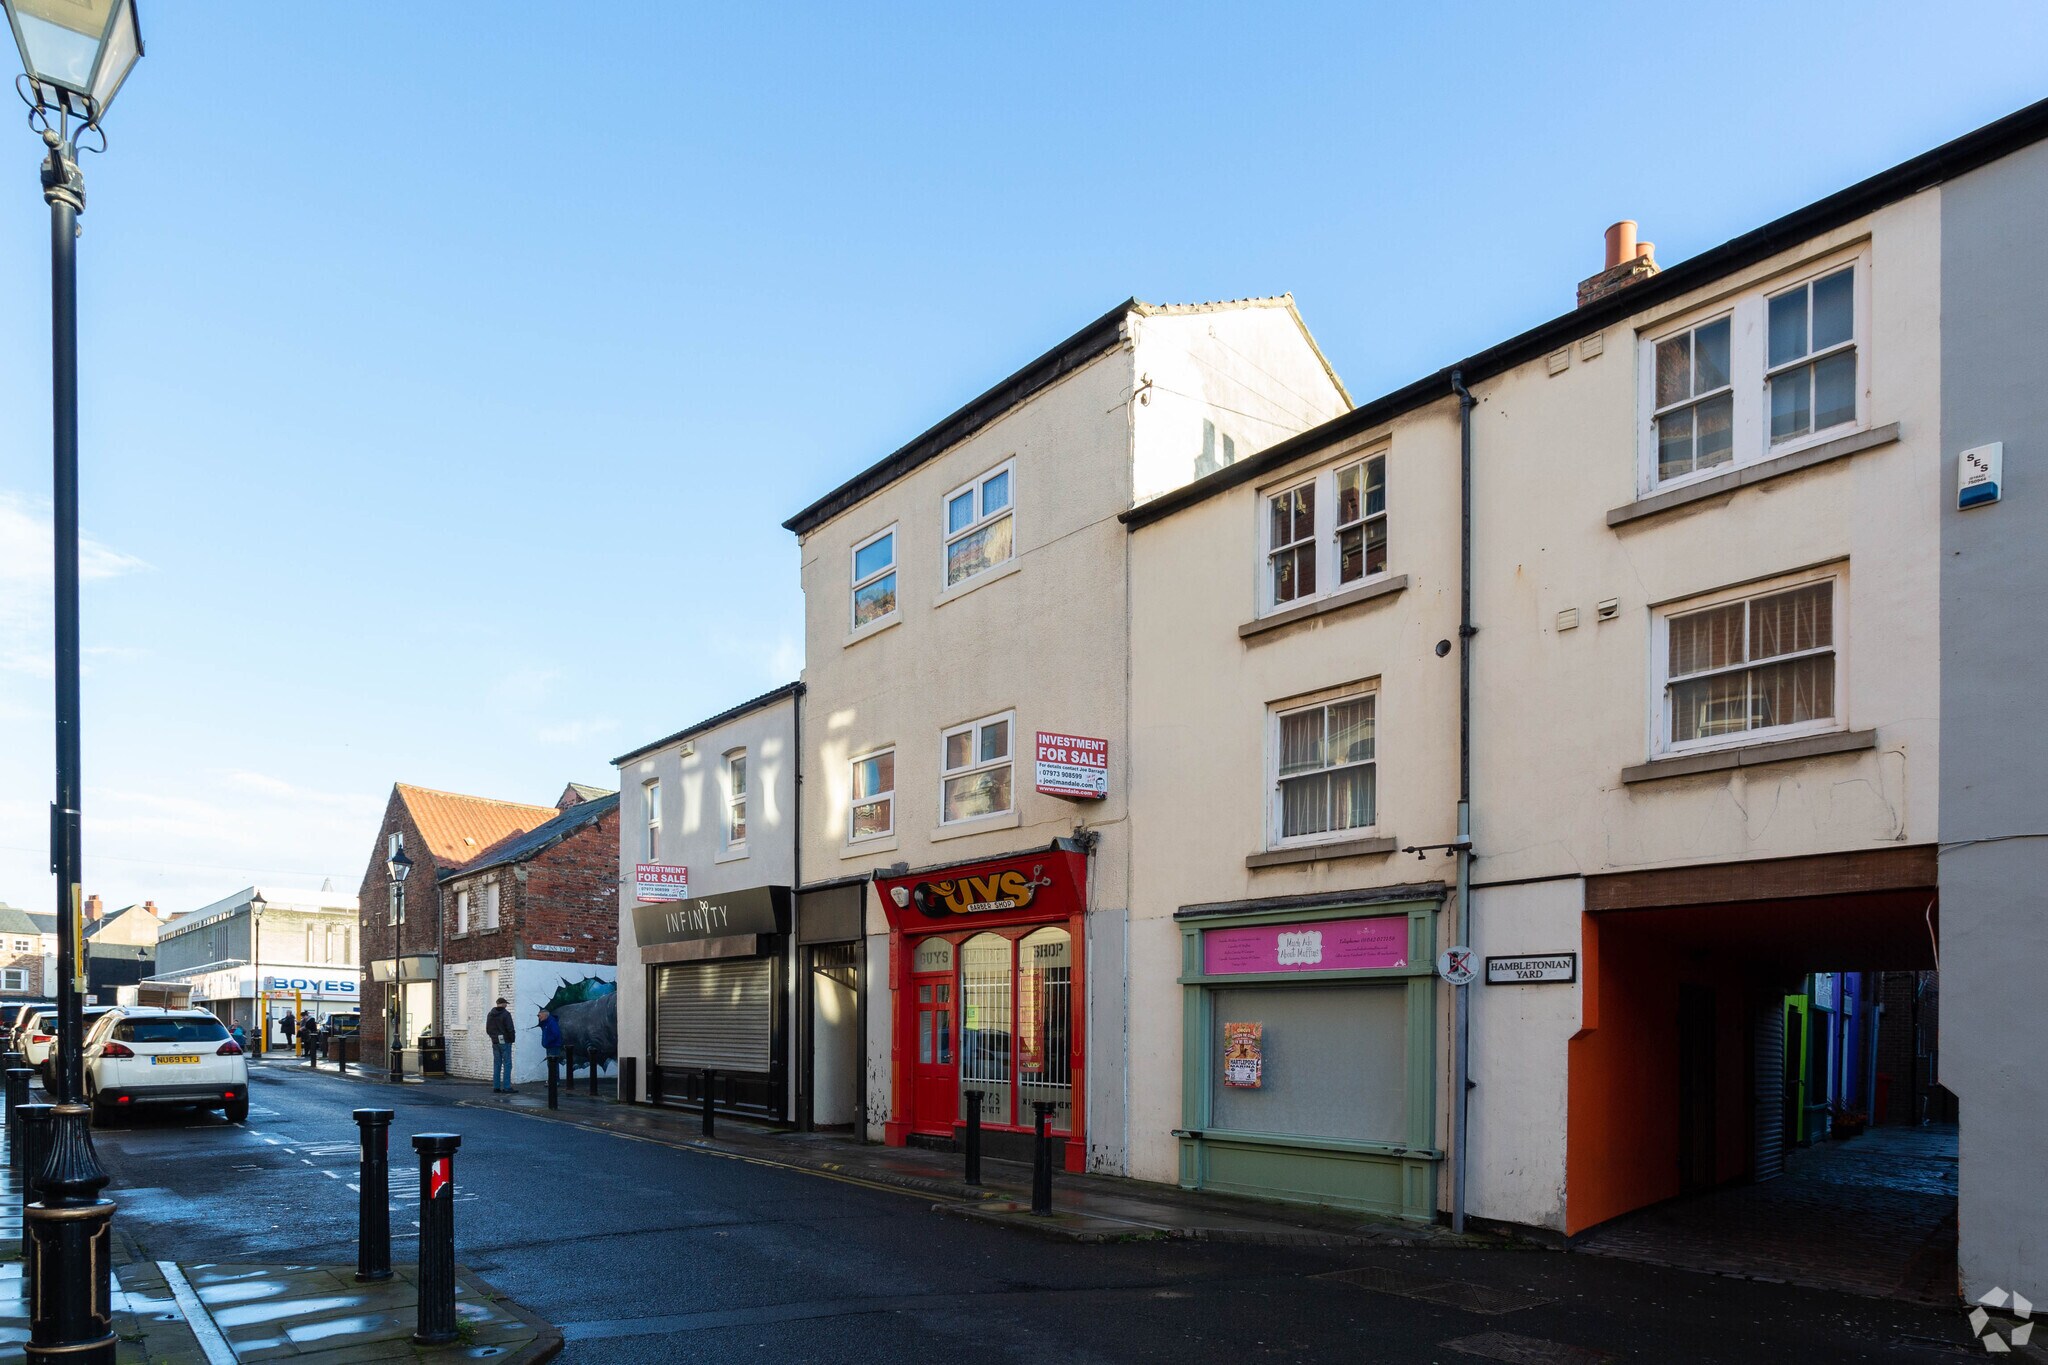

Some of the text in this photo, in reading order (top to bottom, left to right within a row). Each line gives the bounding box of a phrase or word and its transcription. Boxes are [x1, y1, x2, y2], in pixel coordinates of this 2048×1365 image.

[1967, 454, 1988, 472] SES
[1038, 734, 1105, 751] INVESTMENT
[1039, 747, 1106, 767] FOR SALE
[1042, 769, 1060, 777] 07973
[637, 865, 686, 873] INVESTMENT
[638, 873, 686, 883] FOR SALE
[914, 869, 1032, 918] GUYS
[994, 901, 1012, 909] SHOP
[1033, 943, 1063, 958] SHOP
[920, 951, 949, 965] GUYS
[1491, 960, 1571, 971] HAMBLETONIAN
[1516, 970, 1543, 979] YARD
[274, 978, 355, 992] BOYES
[157, 1055, 200, 1063] NU69 ETJ
